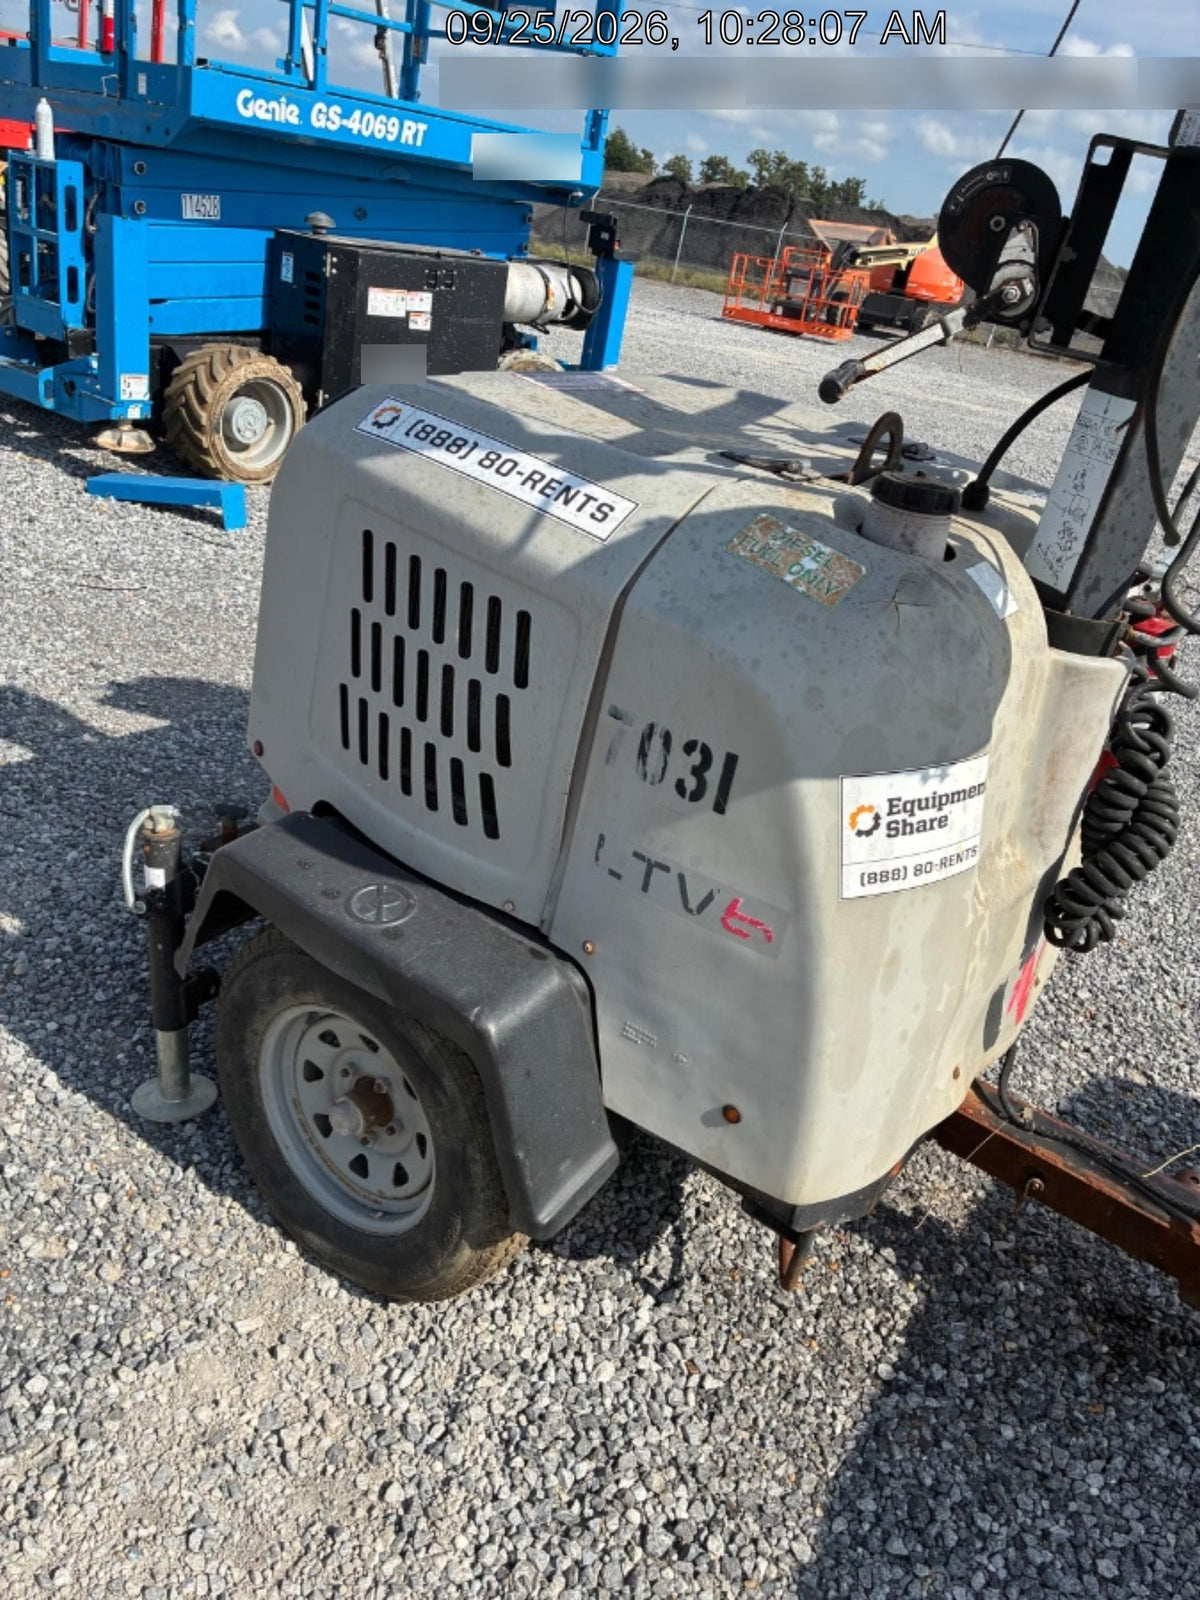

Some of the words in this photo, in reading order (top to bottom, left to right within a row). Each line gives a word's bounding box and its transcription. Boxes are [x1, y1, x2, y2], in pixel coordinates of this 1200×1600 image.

[236, 89, 300, 126] Genie
[310, 102, 400, 142] GS-4069
[401, 119, 428, 147] RT
[404, 418, 479, 460] (888)
[478, 450, 616, 524] 80-RENTS
[738, 533, 782, 569] FUEL
[787, 561, 842, 597] ONLY
[770, 528, 834, 571] DIESEL
[886, 781, 987, 817] Equipmen
[885, 813, 950, 840] Share
[860, 865, 908, 888] (888)
[912, 844, 979, 878] 80-RENTS
